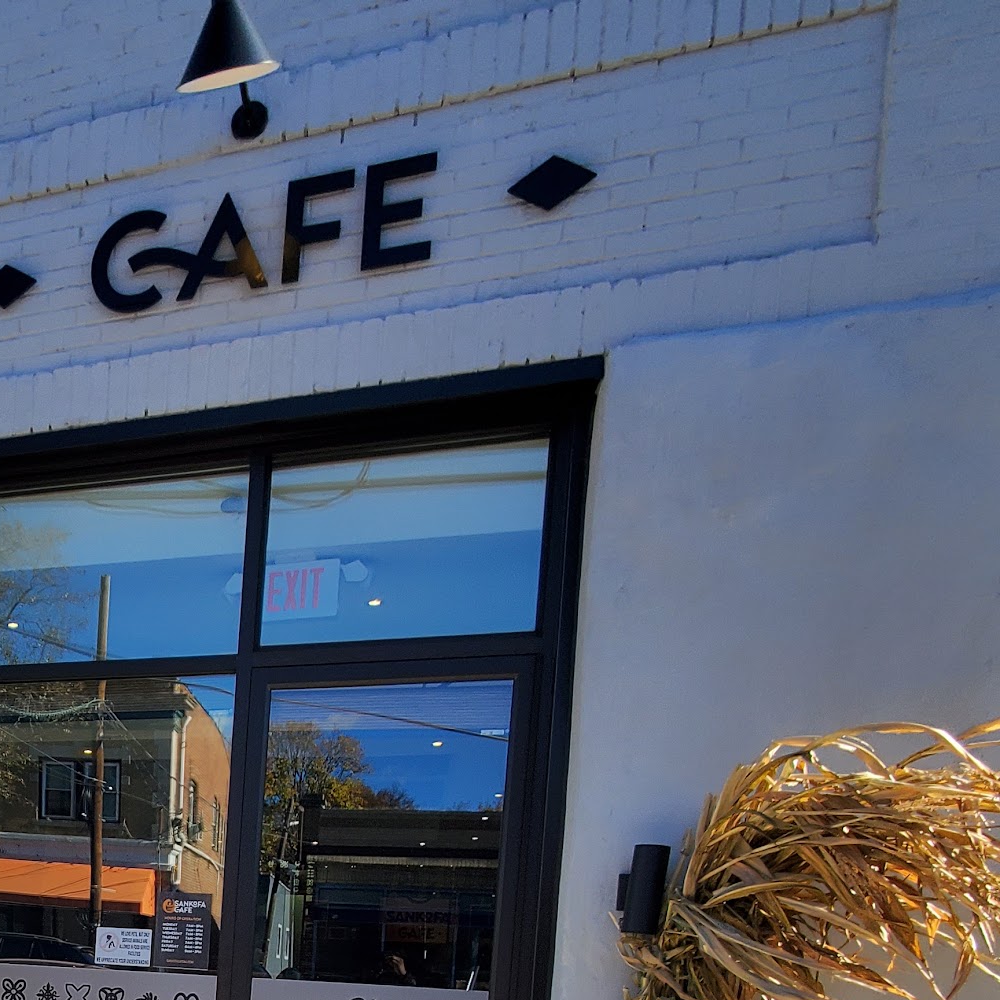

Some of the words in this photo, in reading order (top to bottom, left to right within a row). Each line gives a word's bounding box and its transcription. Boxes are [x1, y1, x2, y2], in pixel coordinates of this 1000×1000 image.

[91, 151, 437, 313] CAFE
[266, 567, 325, 612] EXIT
[173, 906, 193, 914] CAFE
[174, 900, 207, 908] SANKOFA
